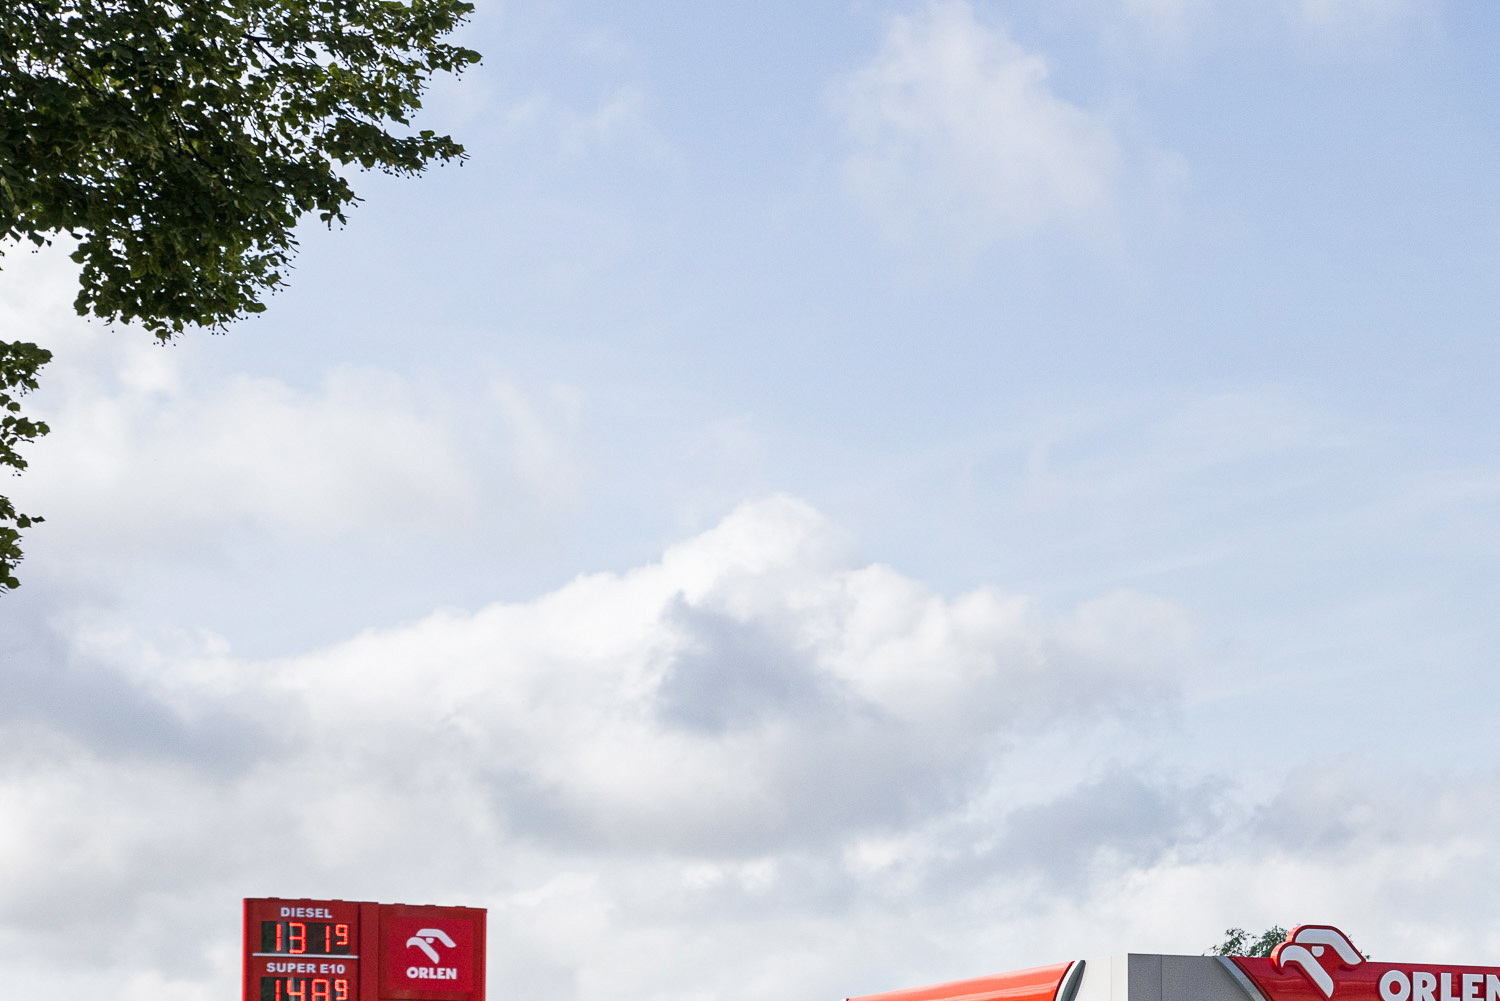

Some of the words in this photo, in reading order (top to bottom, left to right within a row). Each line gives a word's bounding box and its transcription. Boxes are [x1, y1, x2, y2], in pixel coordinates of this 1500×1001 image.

[280, 907, 333, 919] DIESEL
[266, 962, 316, 974] SUPER
[320, 963, 346, 975] E10
[406, 966, 458, 980] ORLEN
